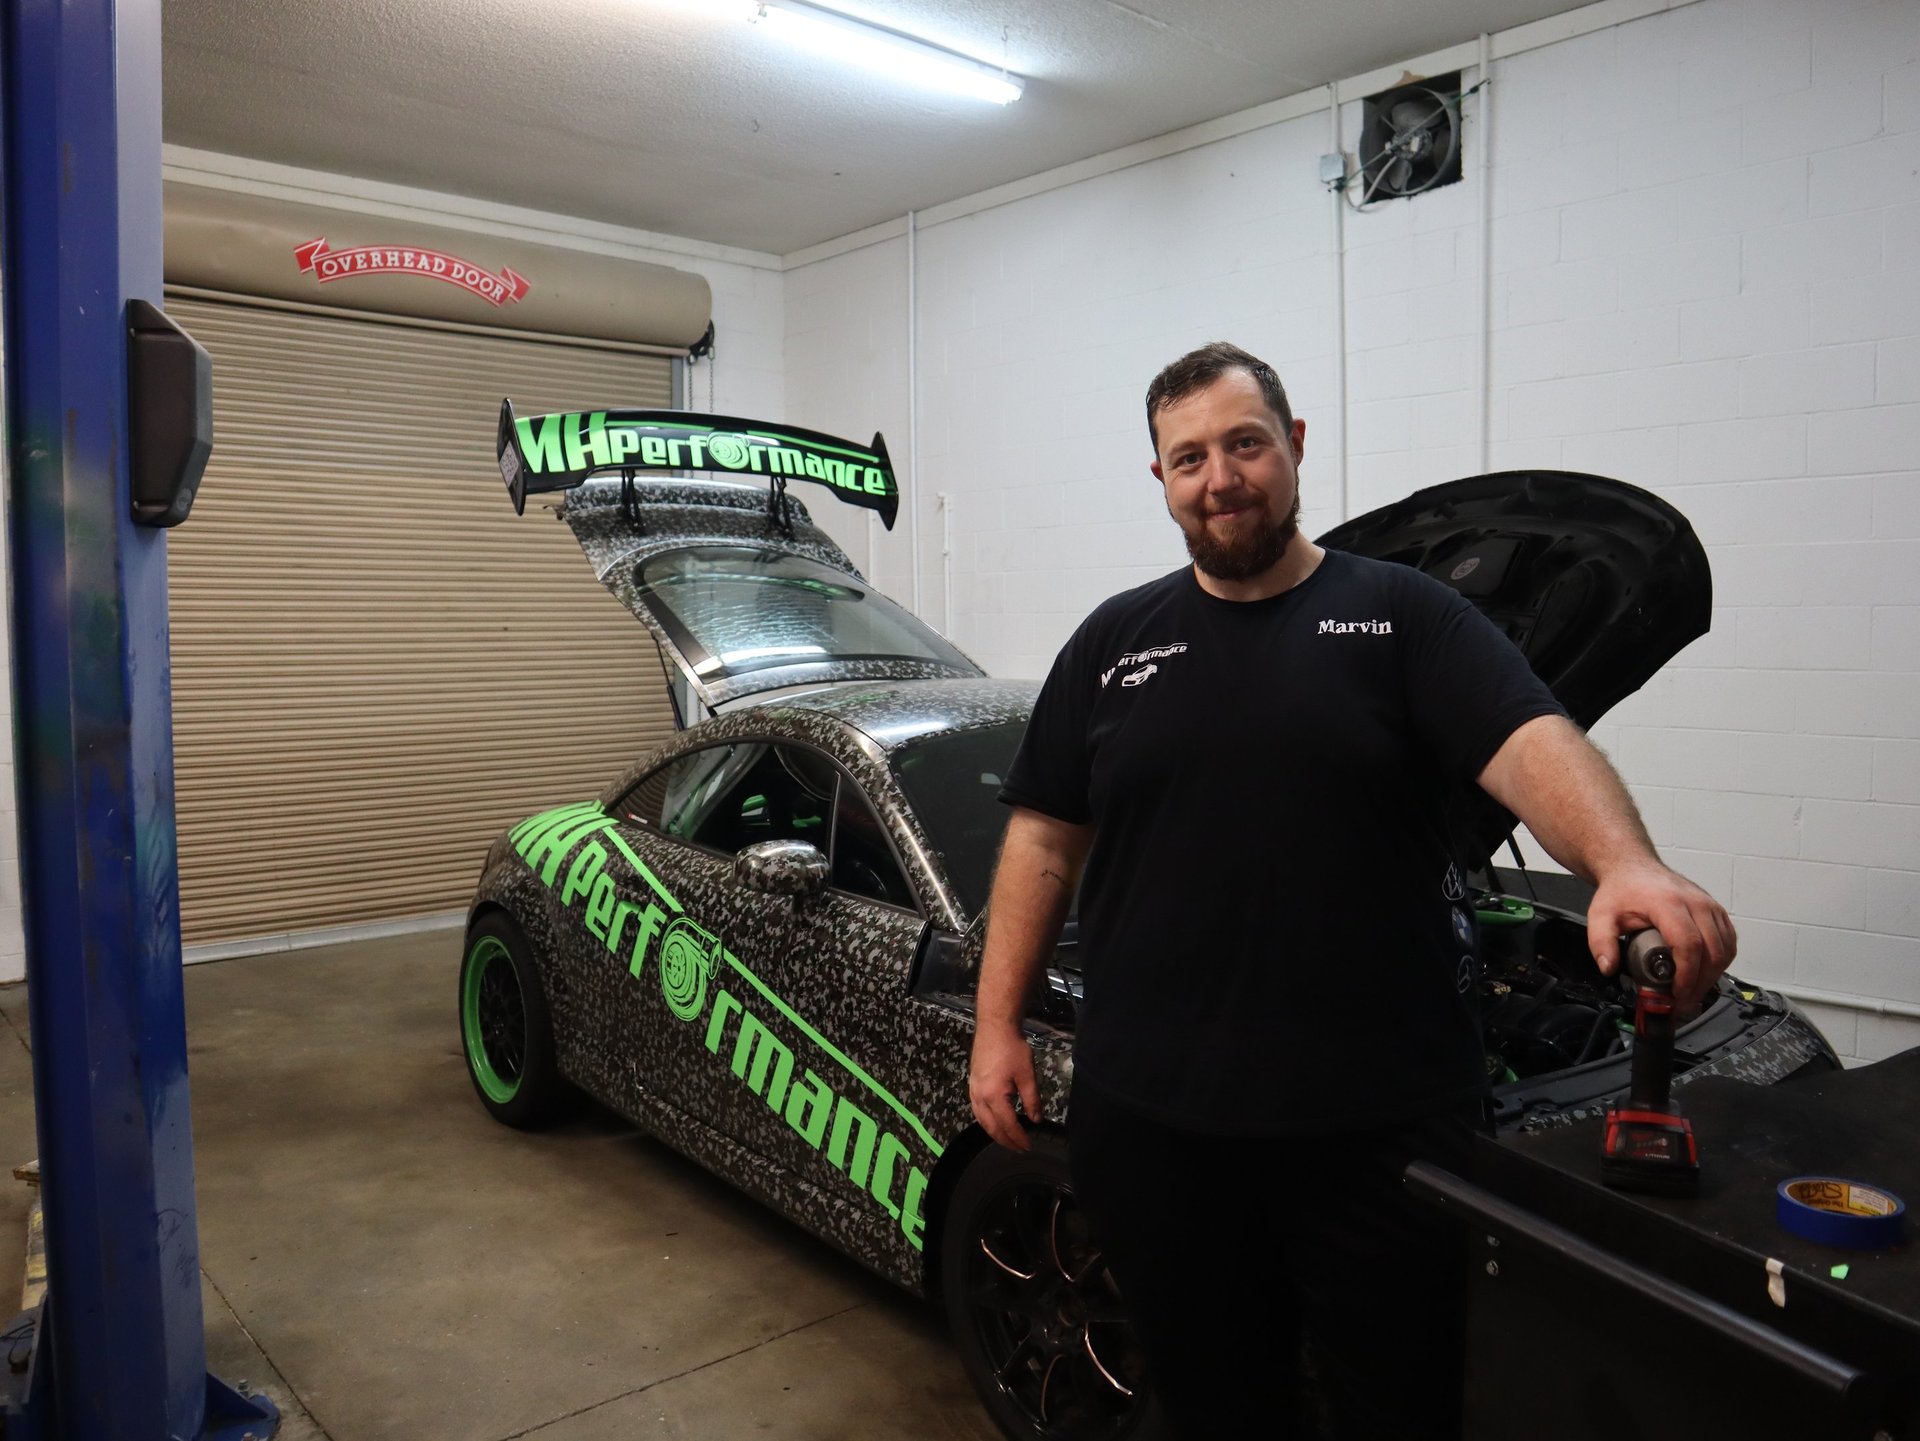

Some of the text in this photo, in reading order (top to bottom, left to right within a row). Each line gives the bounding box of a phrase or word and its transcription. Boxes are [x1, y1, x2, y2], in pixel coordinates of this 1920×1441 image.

[322, 251, 505, 301] OVERHEAD DOOR
[1316, 619, 1393, 635] Marvin
